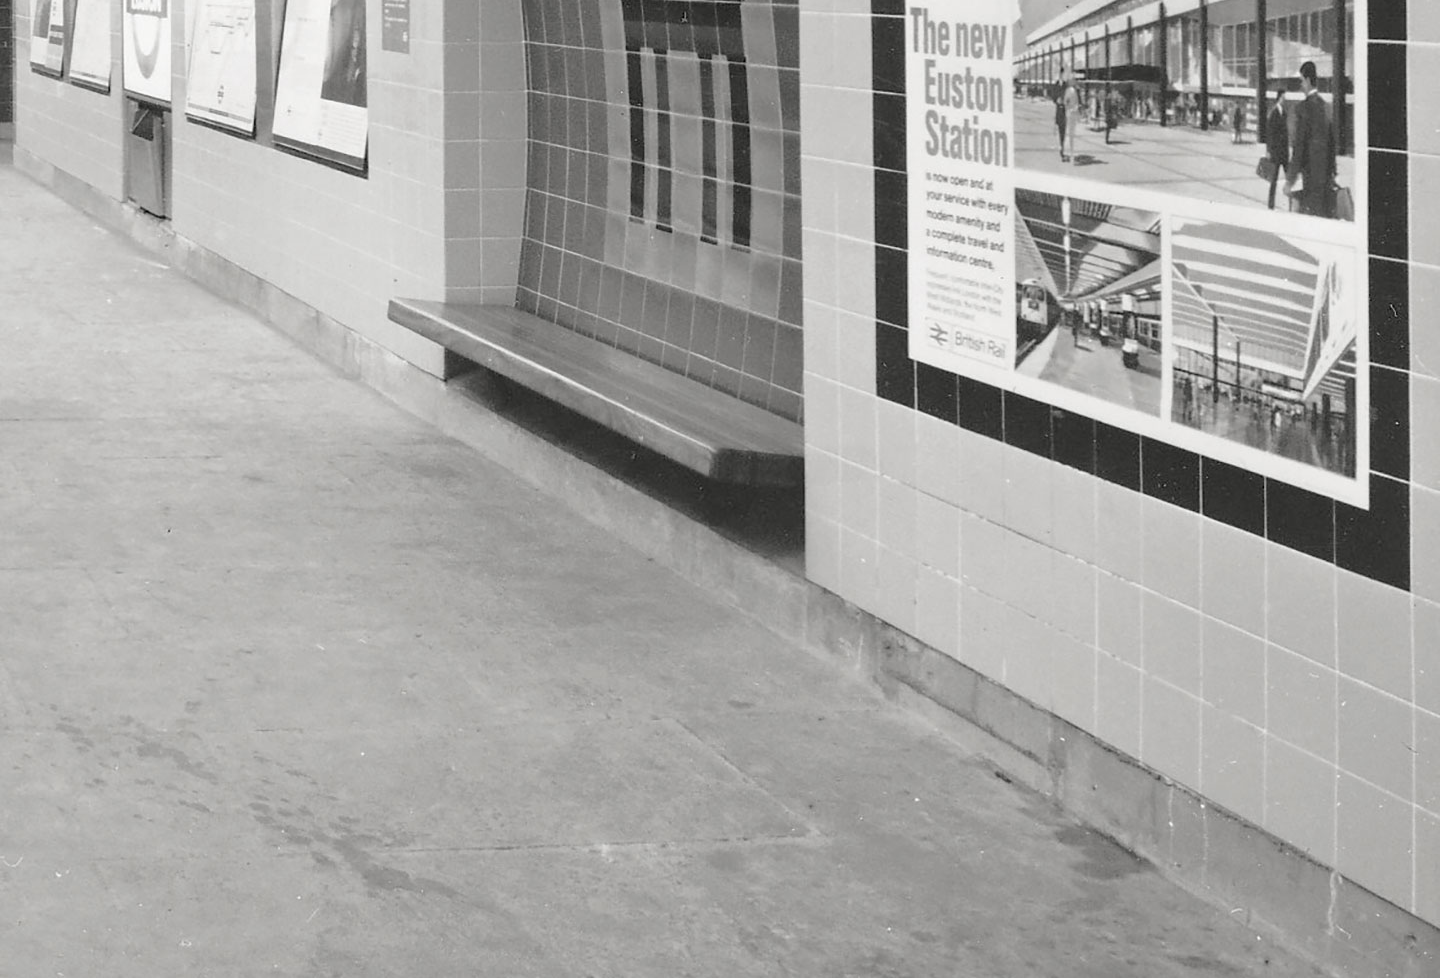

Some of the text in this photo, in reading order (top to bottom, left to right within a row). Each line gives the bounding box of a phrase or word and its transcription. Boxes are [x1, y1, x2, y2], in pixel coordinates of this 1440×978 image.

[910, 7, 1007, 61] The new
[924, 58, 1004, 114] Euston
[925, 109, 1008, 168] Station
[933, 173, 948, 183] now
[950, 175, 969, 187] open
[970, 178, 985, 190] and
[986, 180, 994, 191] at
[926, 191, 1009, 216] your service with every
[926, 209, 1001, 233] modern amenity and
[932, 229, 966, 245] complete
[967, 235, 989, 250] travel
[990, 241, 1005, 253] and
[926, 246, 968, 264] information
[955, 330, 1006, 359] British Rail
